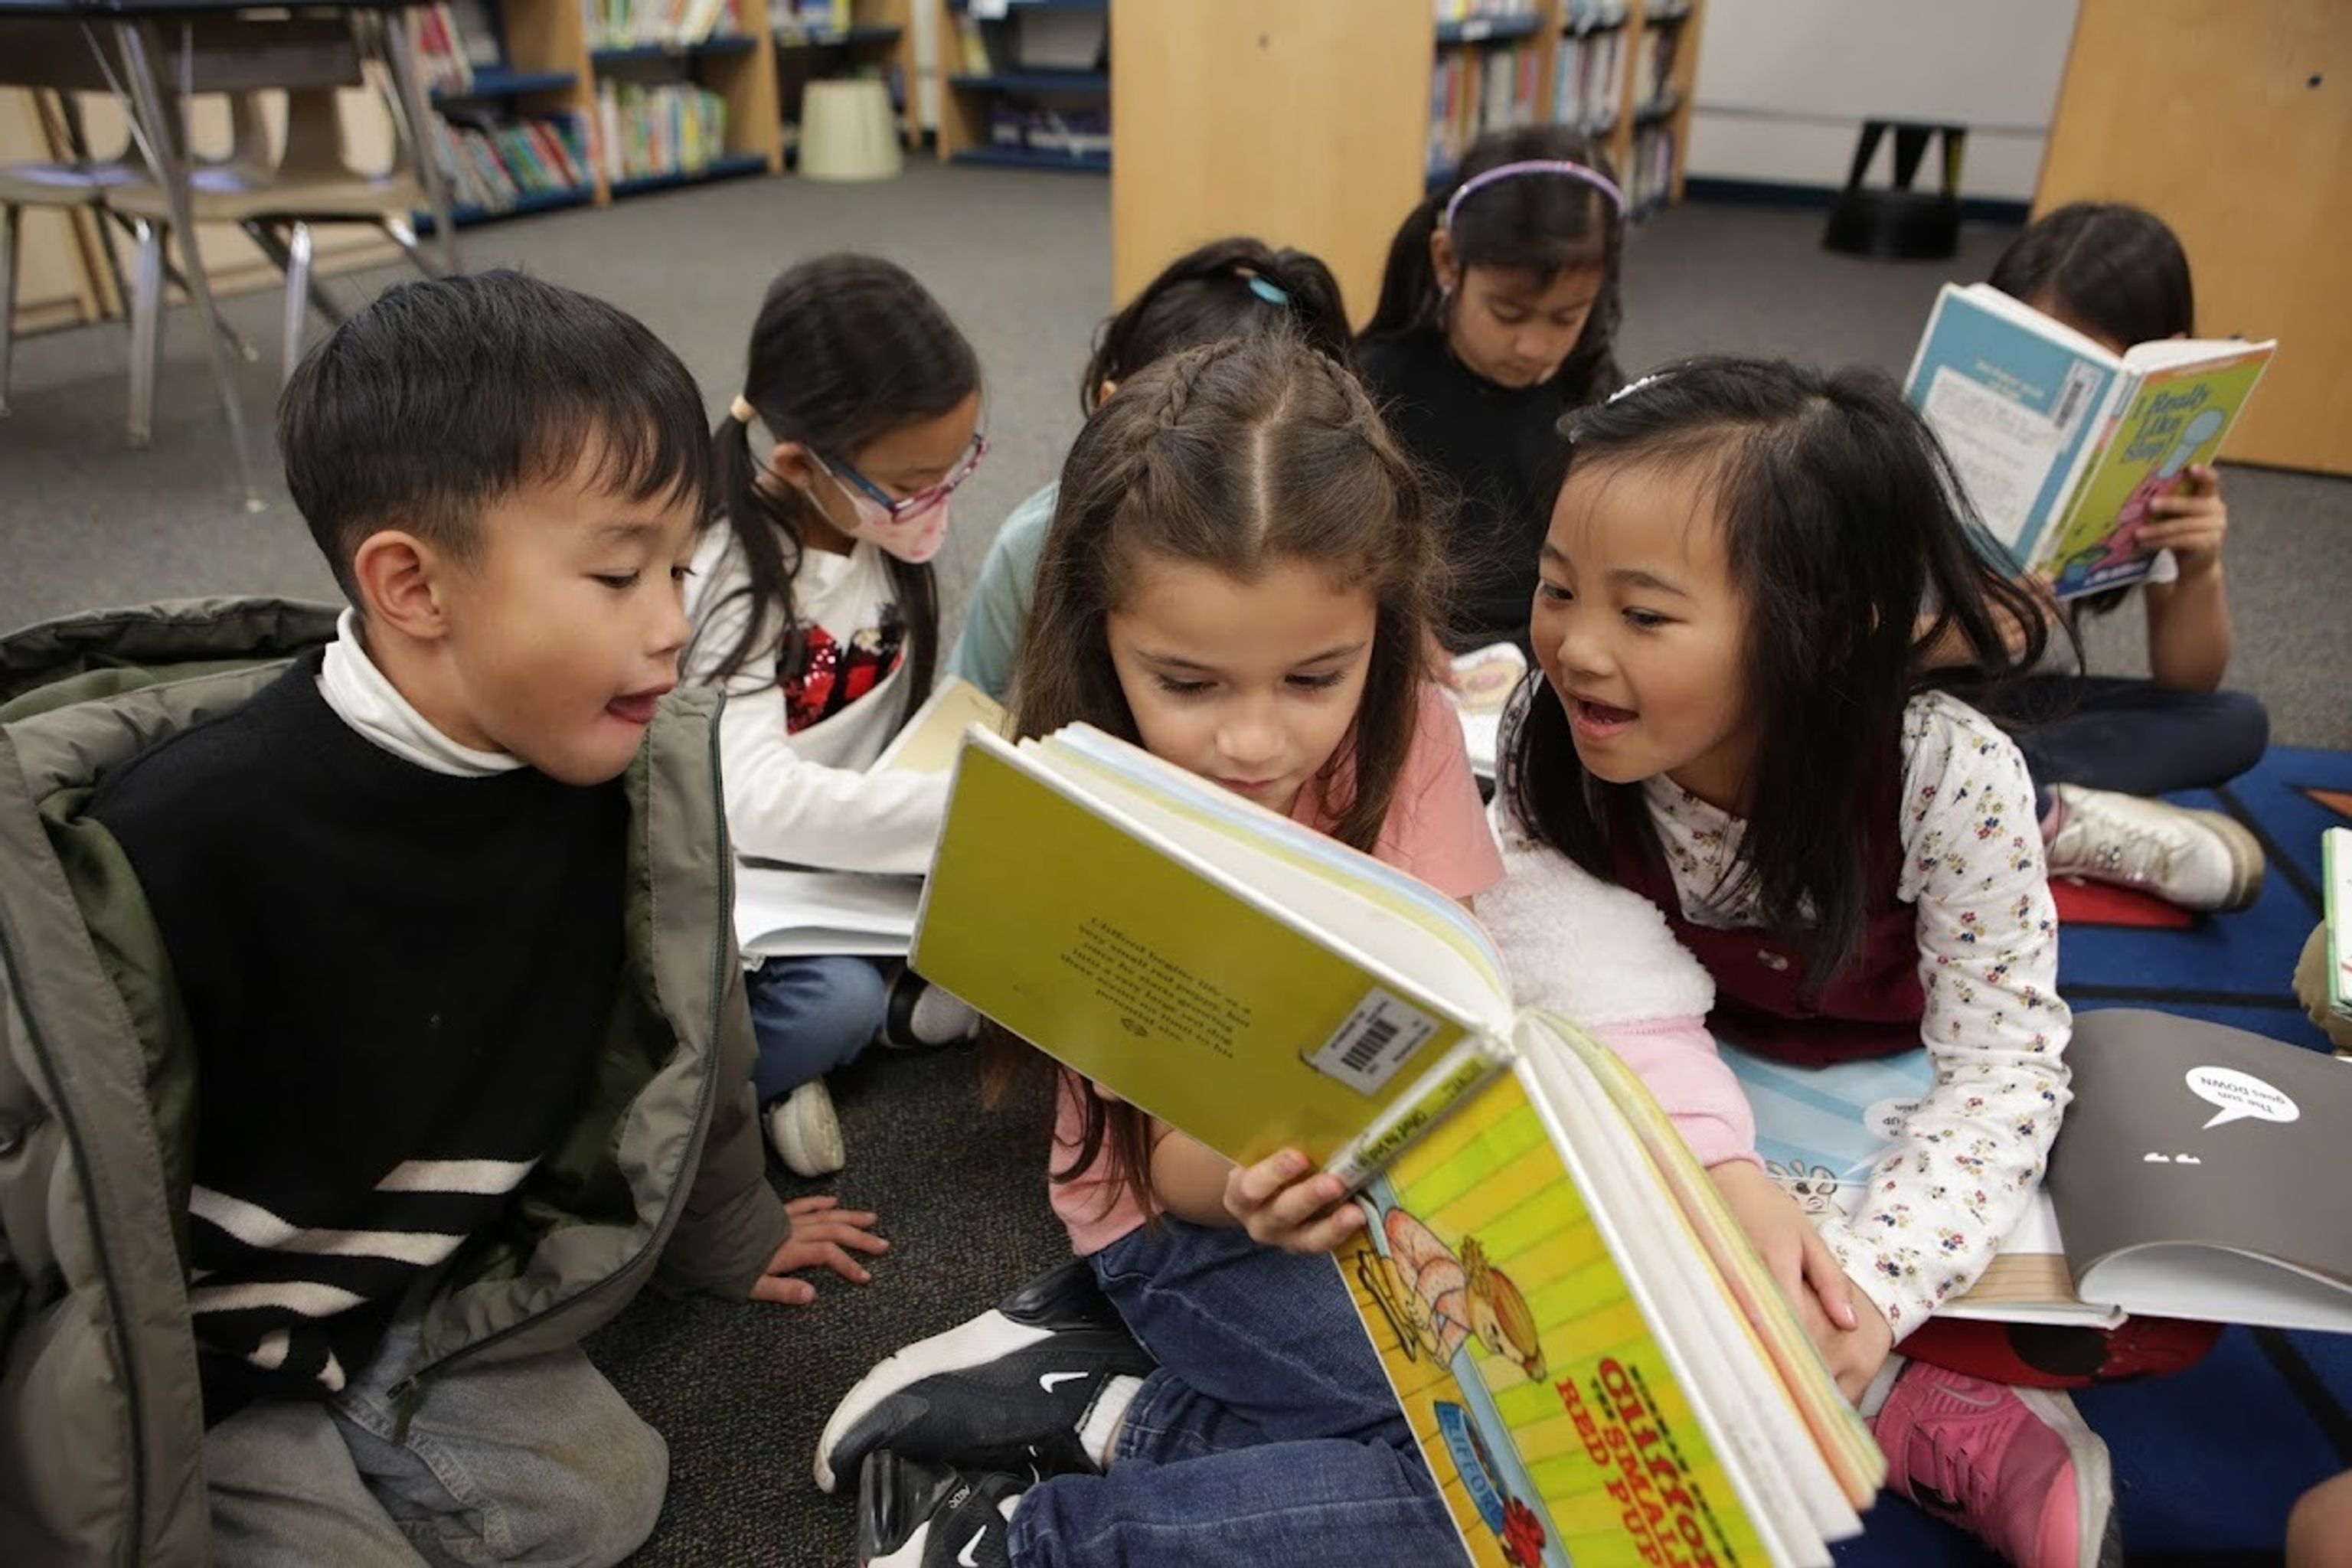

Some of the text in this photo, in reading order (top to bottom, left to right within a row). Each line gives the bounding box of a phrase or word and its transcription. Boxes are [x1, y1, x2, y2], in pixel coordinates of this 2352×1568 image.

[1078, 924, 1107, 946] very
[1110, 943, 1148, 968] small
[1090, 917, 1147, 953] Clifford
[1148, 951, 1194, 982] begins
[1115, 974, 1141, 993] very
[1145, 990, 1175, 1013] large
[2200, 1076, 2249, 1096] DOWN
[1882, 1116, 1901, 1125] UP
[1554, 1377, 1611, 1468] RED
